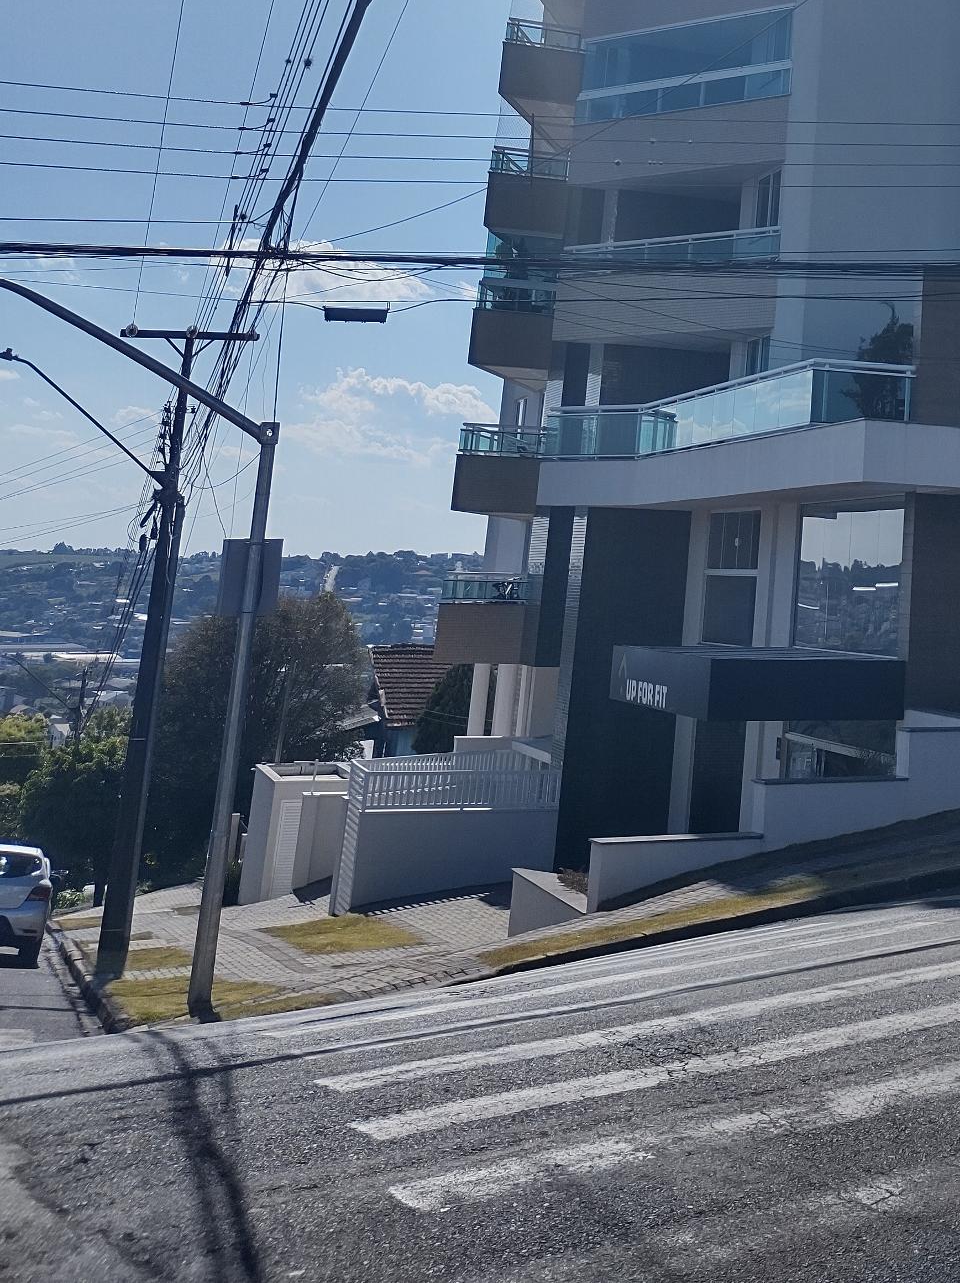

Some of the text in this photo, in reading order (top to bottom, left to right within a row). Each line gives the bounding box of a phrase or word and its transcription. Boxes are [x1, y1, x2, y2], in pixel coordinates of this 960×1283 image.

[625, 678, 668, 709] UP FOR FIT
